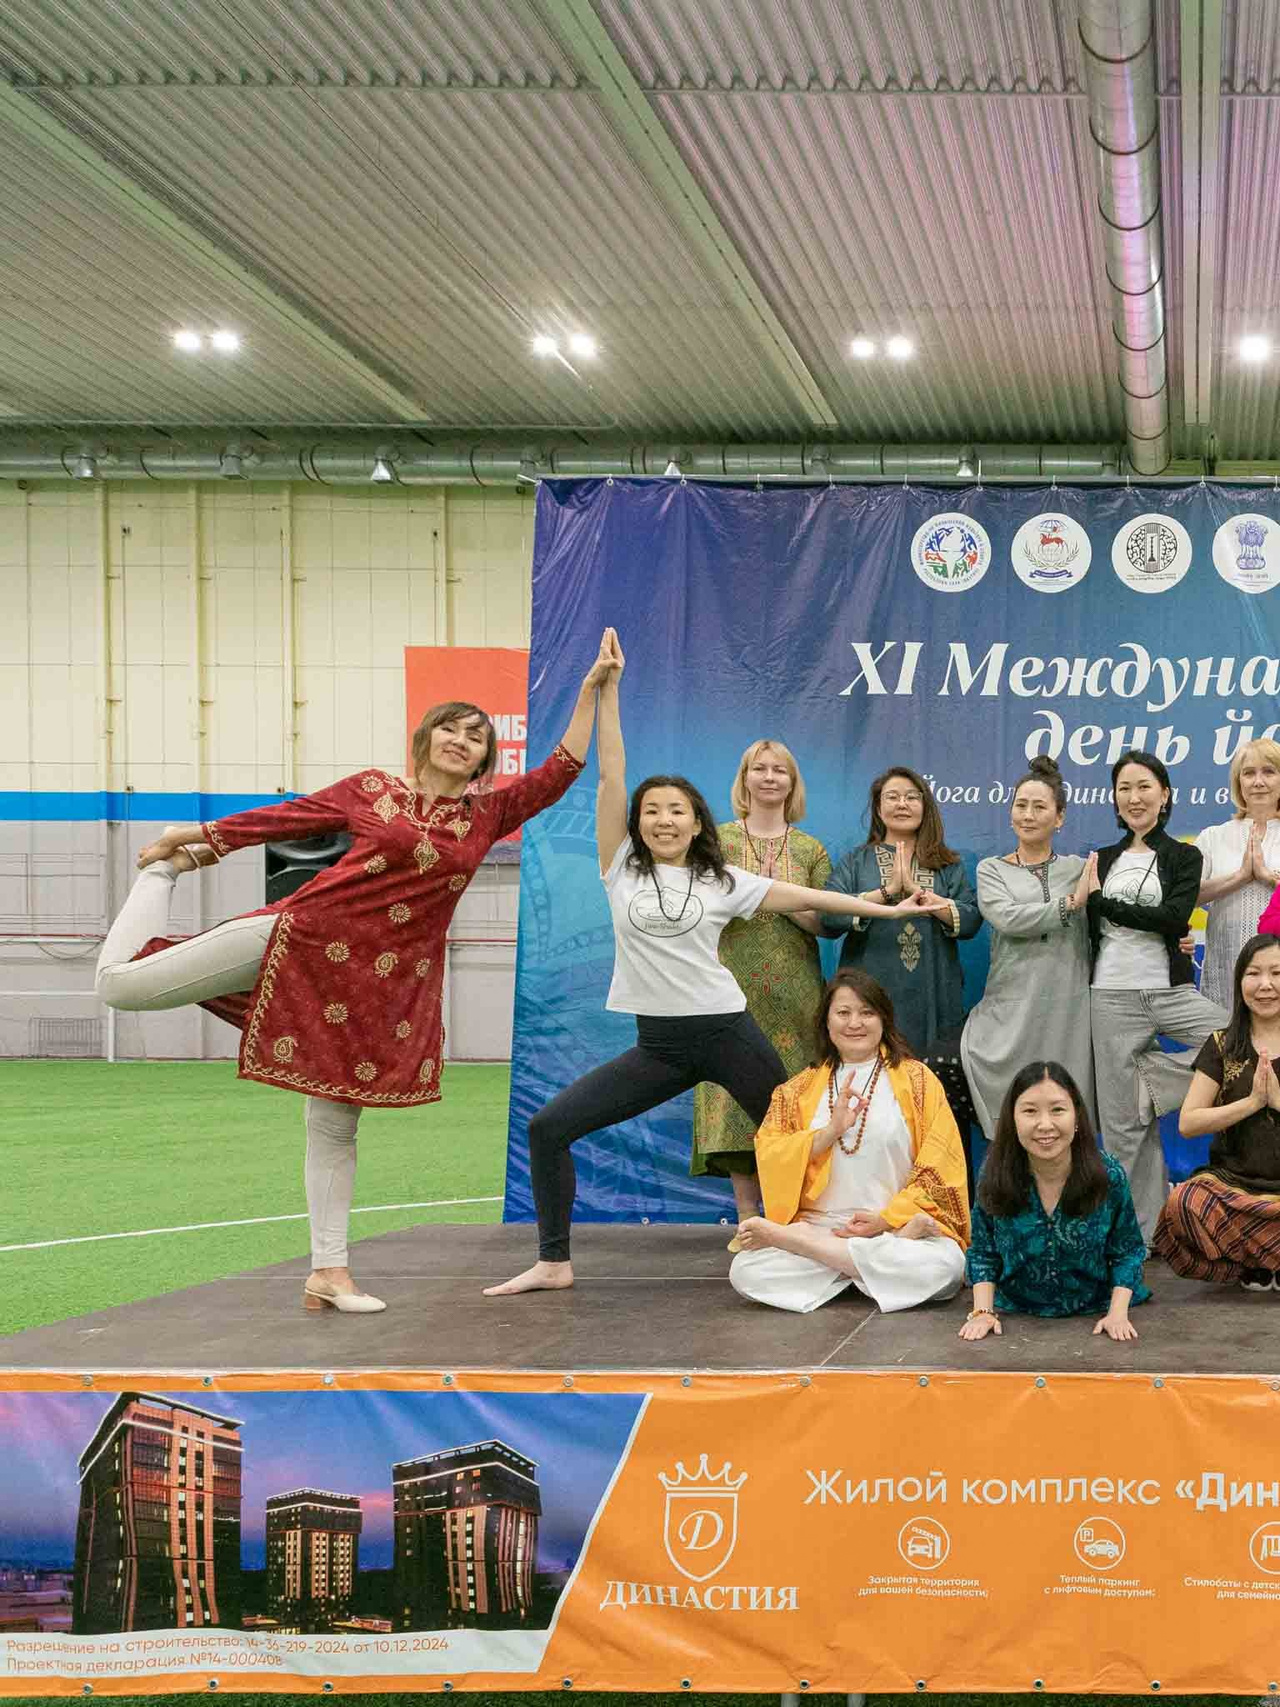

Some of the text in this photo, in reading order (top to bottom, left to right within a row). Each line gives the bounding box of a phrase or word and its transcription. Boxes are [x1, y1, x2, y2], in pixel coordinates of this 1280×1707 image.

[1024, 710, 1191, 766] день
[1191, 787, 1207, 804] и
[804, 1470, 947, 1505] Жилой
[962, 1477, 1161, 1506] комплекс
[679, 1510, 724, 1550] D
[868, 1576, 980, 1587] Закрытая территория
[600, 1581, 800, 1611] ДИНАСТИЯ
[7, 1640, 95, 1655] Разрешение
[100, 1643, 120, 1653] на
[353, 1643, 371, 1653] от
[374, 1637, 449, 1653] 10.12.2024
[7, 1657, 82, 1672] Проектная
[86, 1653, 185, 1673] декларация
